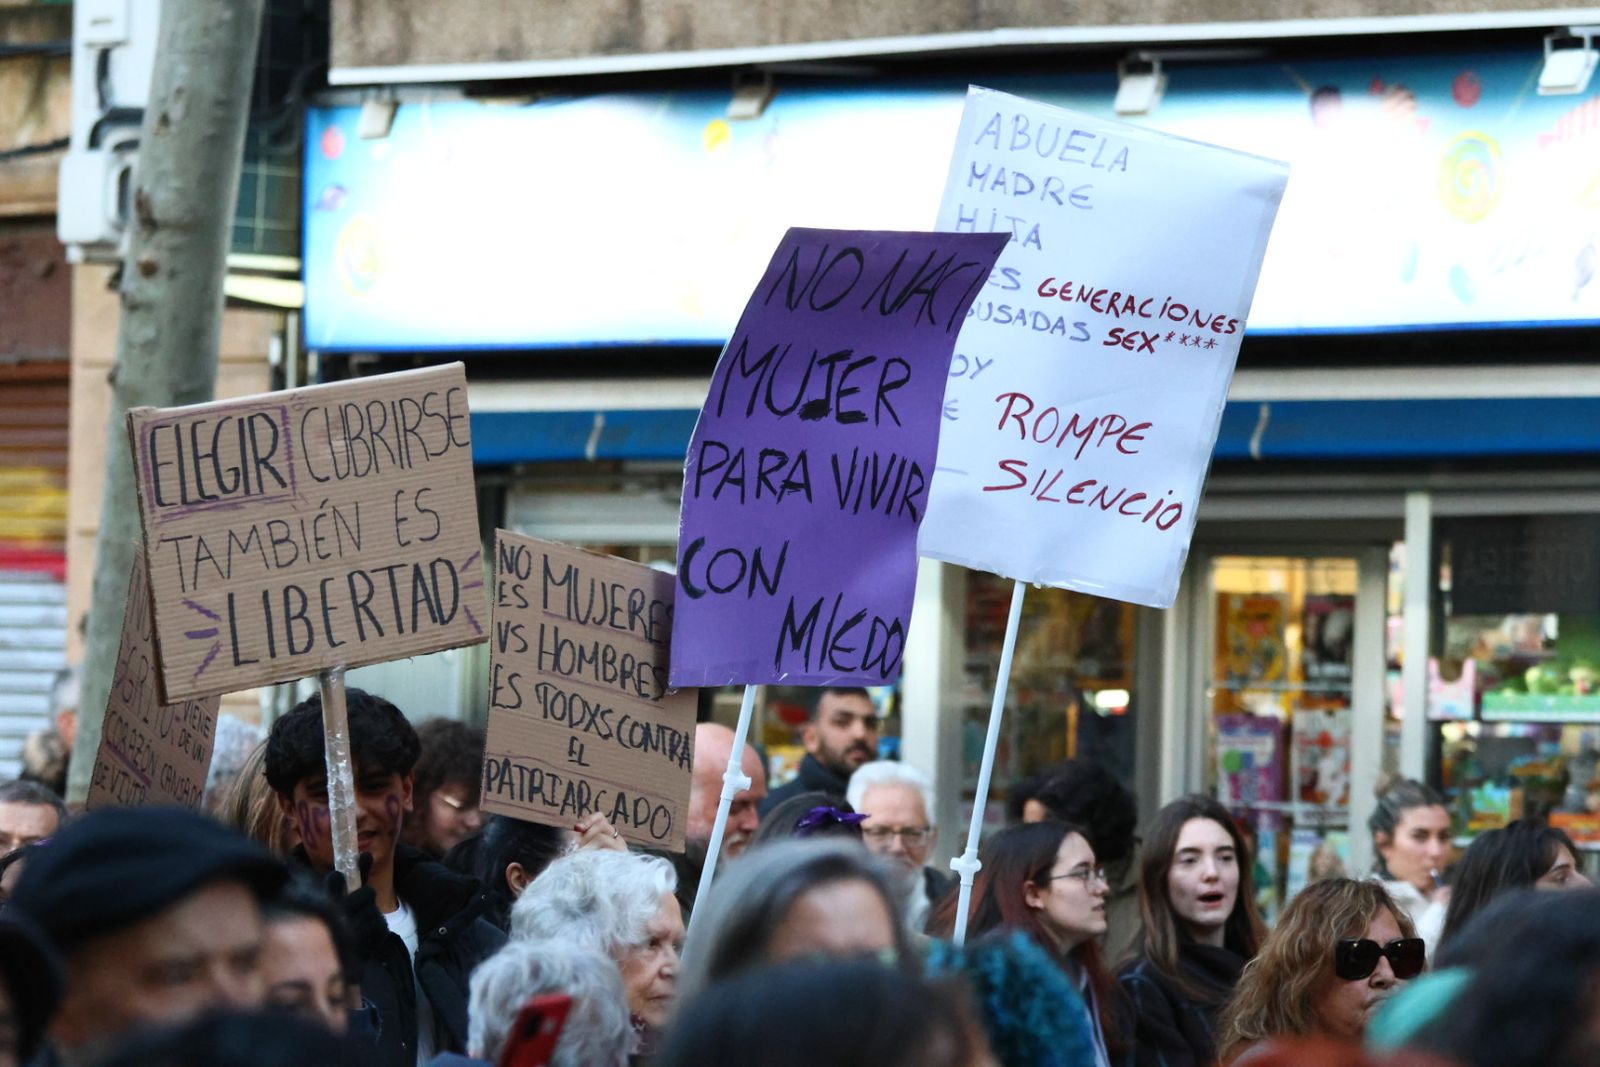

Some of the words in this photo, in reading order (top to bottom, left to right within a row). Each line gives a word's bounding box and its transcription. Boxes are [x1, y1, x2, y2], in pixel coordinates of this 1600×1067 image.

[975, 112, 1129, 172] ABUELA
[967, 161, 1094, 210] MADRE
[764, 243, 864, 313] NO
[967, 301, 1092, 343] USADAS
[716, 334, 912, 428] MUJER
[949, 354, 994, 380] OY
[150, 411, 288, 508] ELEGIR
[301, 387, 470, 483] CUBRIRSE
[995, 392, 1153, 461] ROMPE
[694, 440, 813, 505] PARA
[831, 446, 925, 524] VIVIR
[159, 498, 361, 593] TAMBIÉN
[394, 487, 441, 548] ES
[499, 539, 532, 581] NO
[679, 536, 790, 600] CON
[227, 557, 460, 668] LIBERTAD
[498, 581, 529, 609] ES
[497, 620, 528, 653] VS
[538, 622, 669, 701] HOMBRES
[774, 591, 905, 680] MIEDO
[491, 664, 522, 710] ES
[535, 682, 614, 741] TODXS
[616, 713, 692, 773] CONTRA
[568, 735, 591, 768] EL
[485, 757, 672, 840] PATRIARCADO
